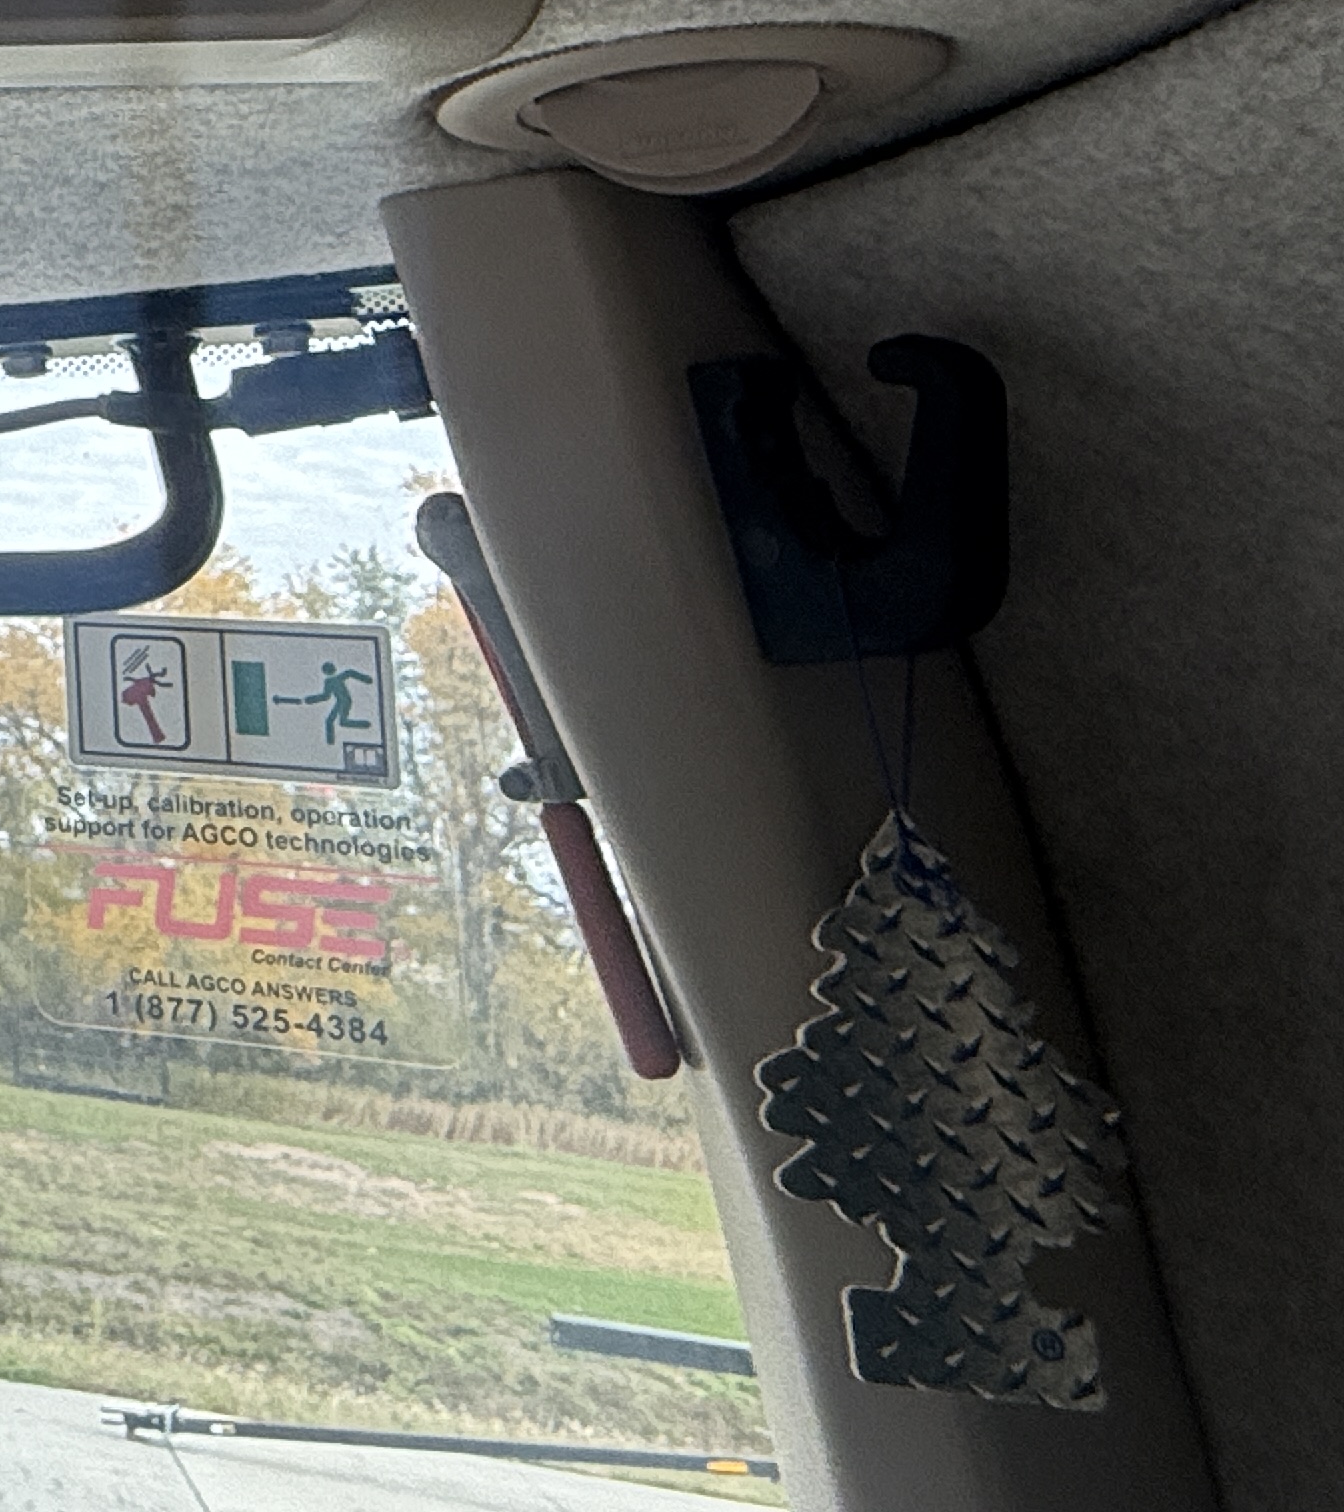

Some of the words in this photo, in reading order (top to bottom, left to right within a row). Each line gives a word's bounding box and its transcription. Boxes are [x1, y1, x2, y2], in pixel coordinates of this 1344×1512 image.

[58, 787, 139, 814] Set-up,
[147, 793, 282, 825] calibration,
[291, 806, 411, 830] operation
[45, 816, 135, 839] support
[141, 819, 176, 841] for
[182, 823, 259, 848] AGCO
[265, 830, 431, 864] technologies
[87, 863, 392, 958] FUSE
[252, 949, 322, 970] Contact
[328, 958, 392, 977] Center
[129, 967, 181, 988] CALL
[185, 974, 246, 996] AGCO
[251, 981, 358, 1007] ANSWERS
[106, 991, 119, 1016] 1
[135, 993, 218, 1031] (877)
[232, 1004, 388, 1046] 525-4384
